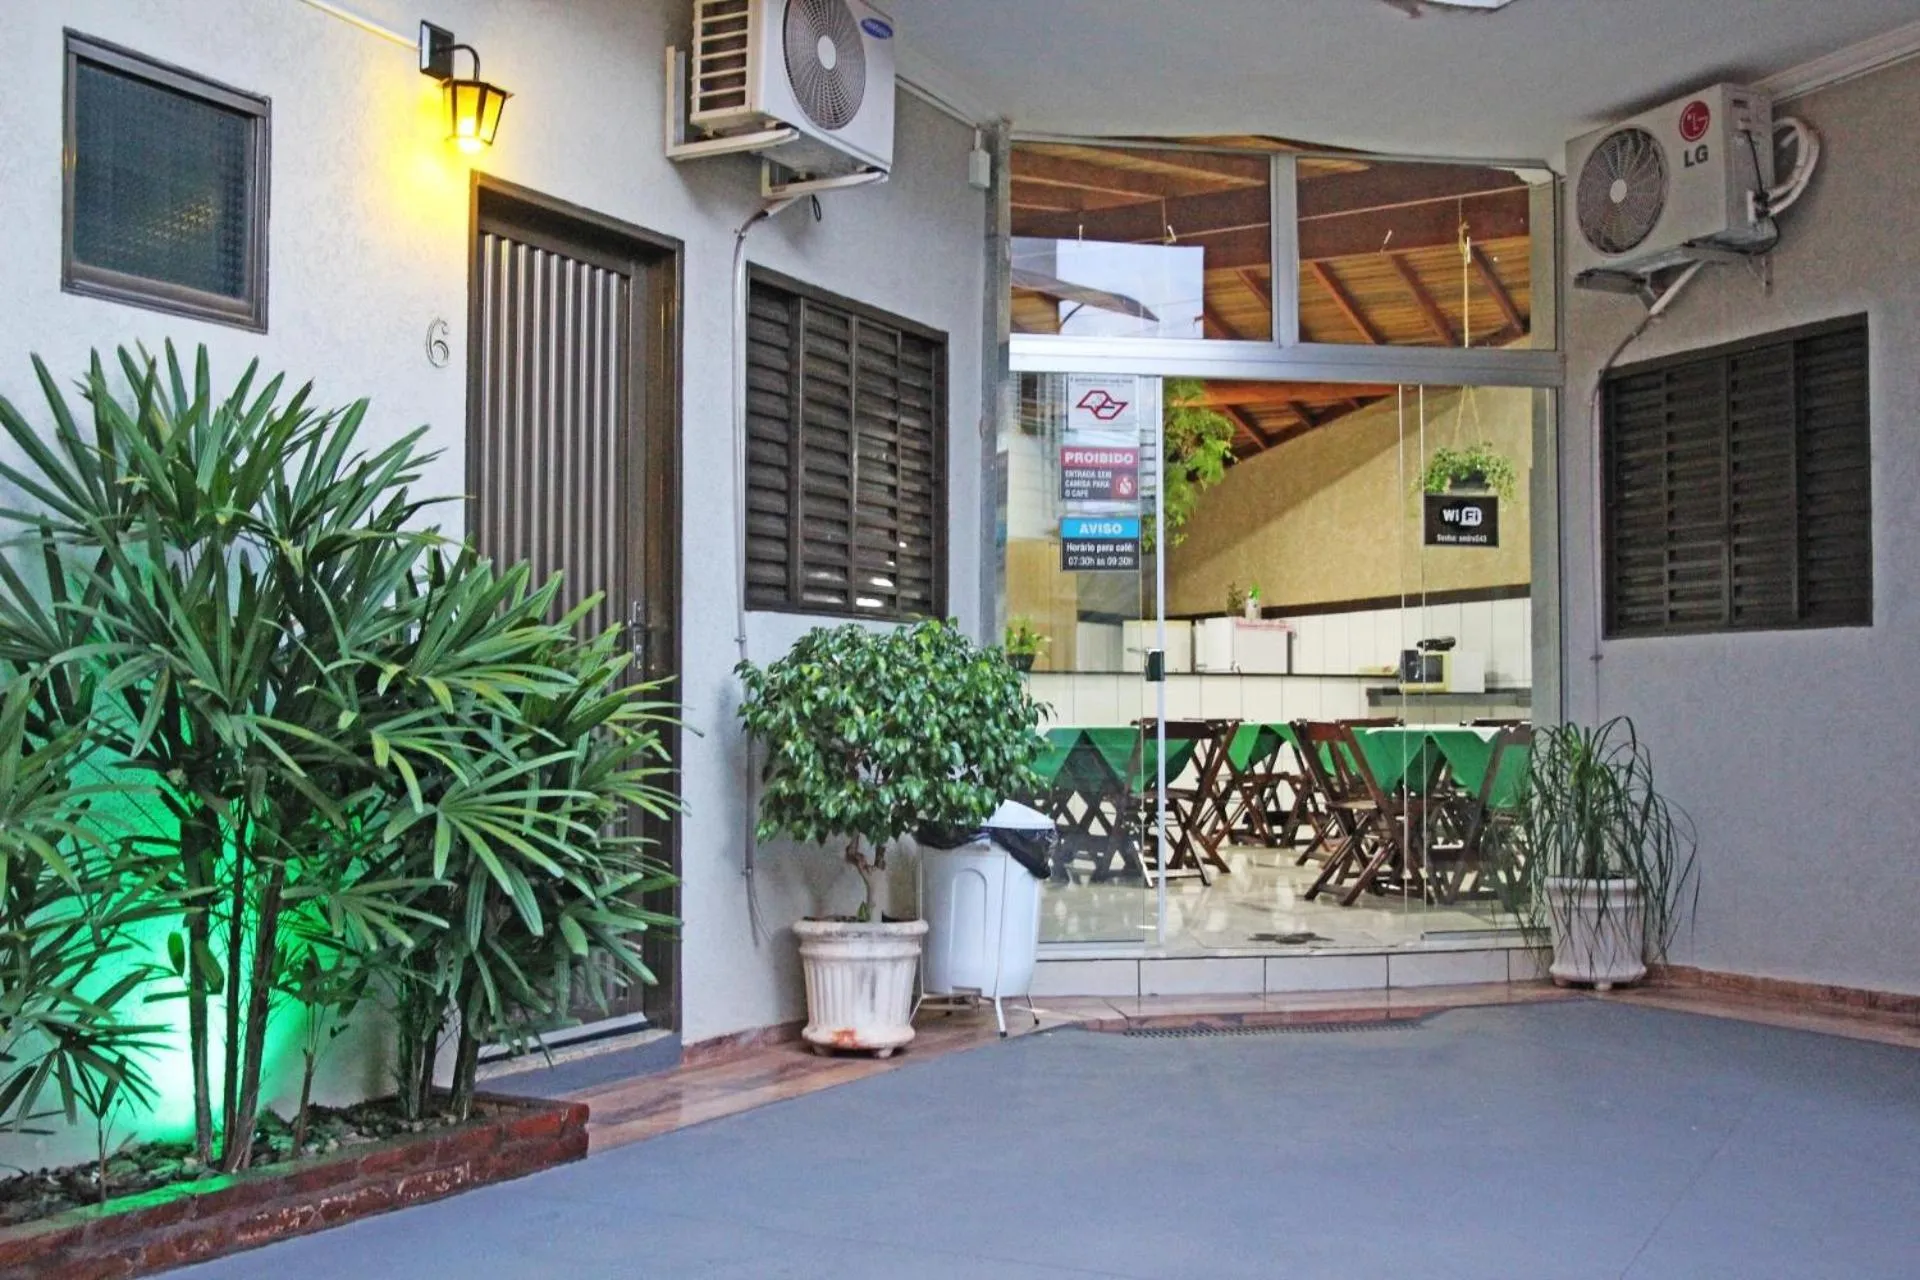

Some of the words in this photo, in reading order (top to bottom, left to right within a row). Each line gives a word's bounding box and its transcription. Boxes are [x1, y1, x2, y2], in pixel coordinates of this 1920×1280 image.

[1684, 144, 1709, 168] LG
[425, 317, 449, 369] 6
[1064, 451, 1134, 465] PROIBIDO
[1080, 523, 1123, 535] AVISO
[1096, 543, 1115, 554] para
